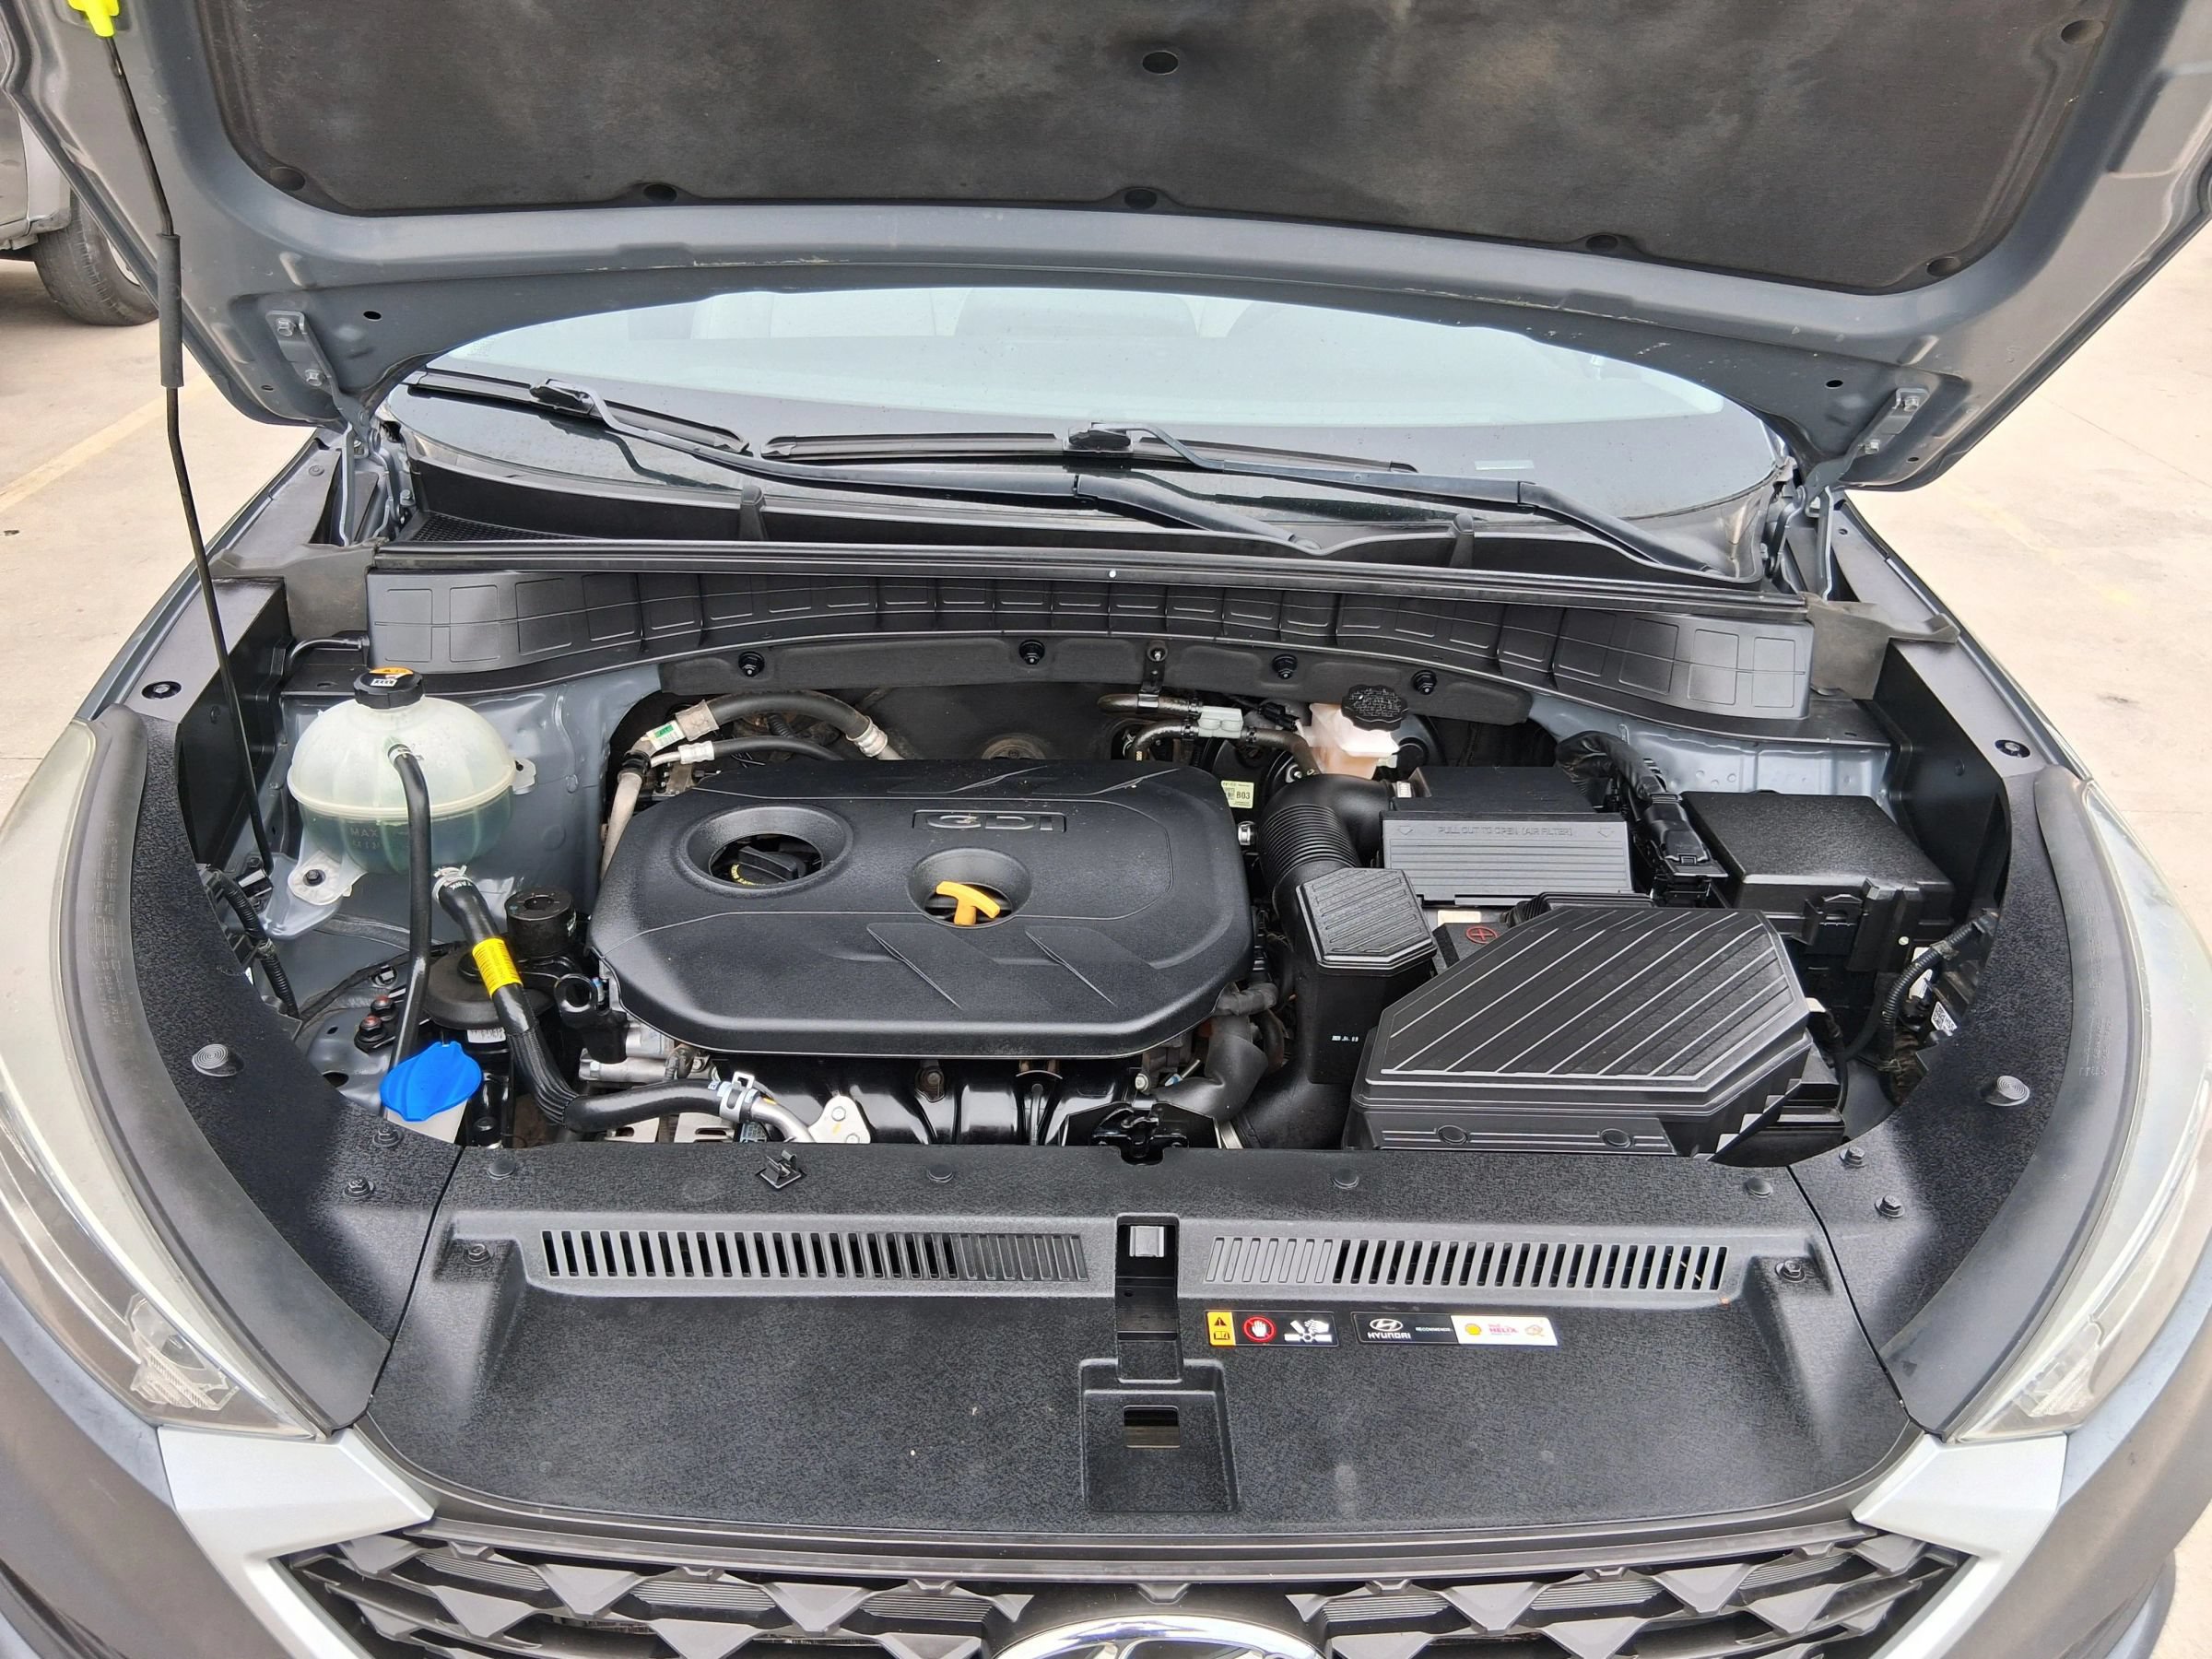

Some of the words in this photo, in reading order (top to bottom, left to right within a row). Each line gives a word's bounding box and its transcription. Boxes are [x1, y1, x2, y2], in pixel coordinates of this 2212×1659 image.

[1236, 791, 1251, 800] B03
[926, 814, 1053, 831] GDI
[350, 828, 378, 838] MAX
[1438, 826, 1460, 834] PULL
[1461, 826, 1480, 834] OUT
[1494, 827, 1519, 835] OPEN
